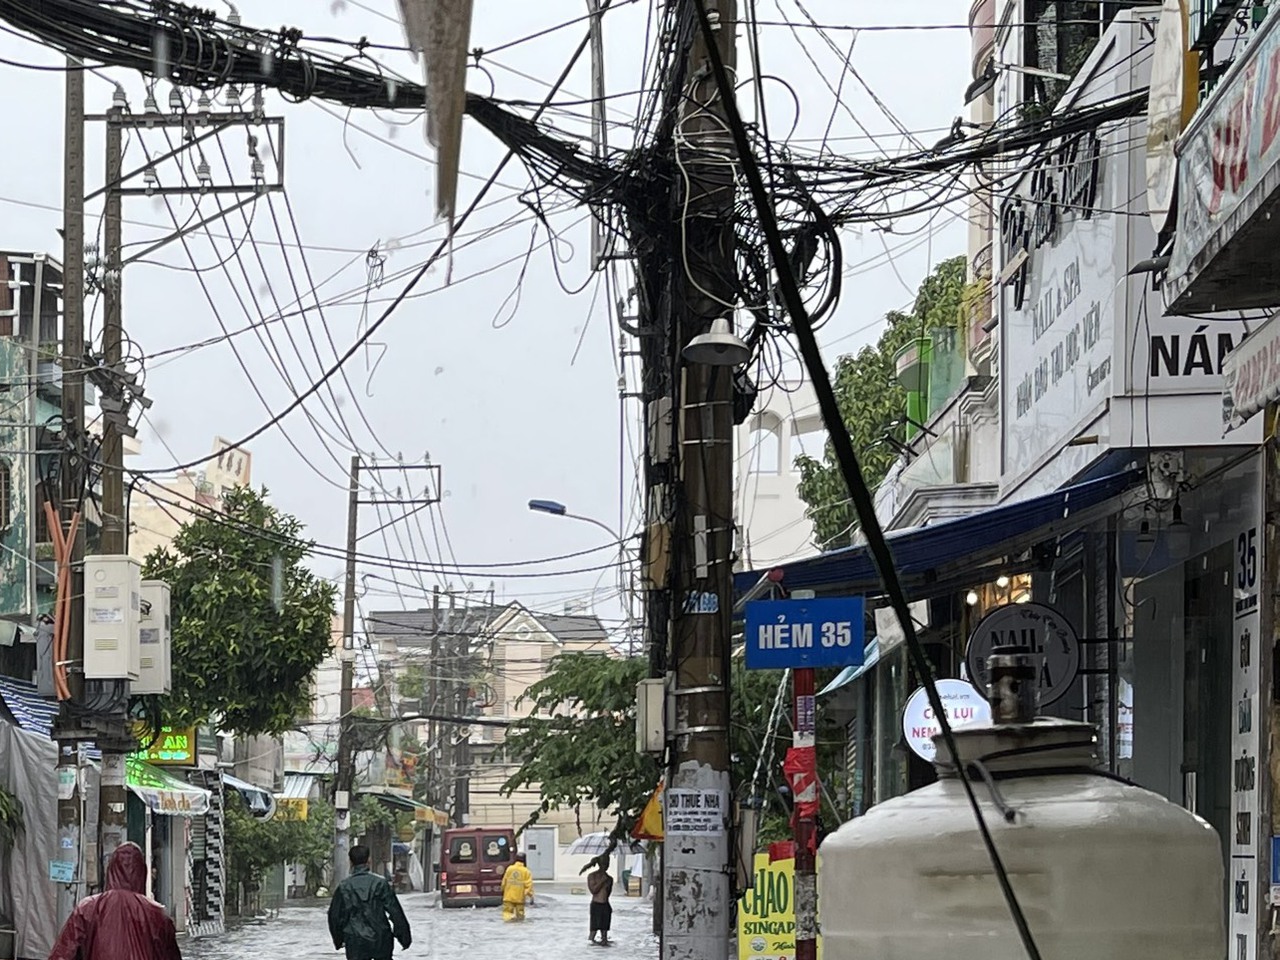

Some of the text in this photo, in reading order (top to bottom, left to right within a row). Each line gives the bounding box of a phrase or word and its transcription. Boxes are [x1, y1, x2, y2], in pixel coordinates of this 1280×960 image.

[1032, 288, 1055, 345] NAIL
[1064, 256, 1081, 311] SPA
[1238, 528, 1256, 590] 35
[759, 615, 852, 649] HẺM 35
[991, 628, 1044, 654] NAIL
